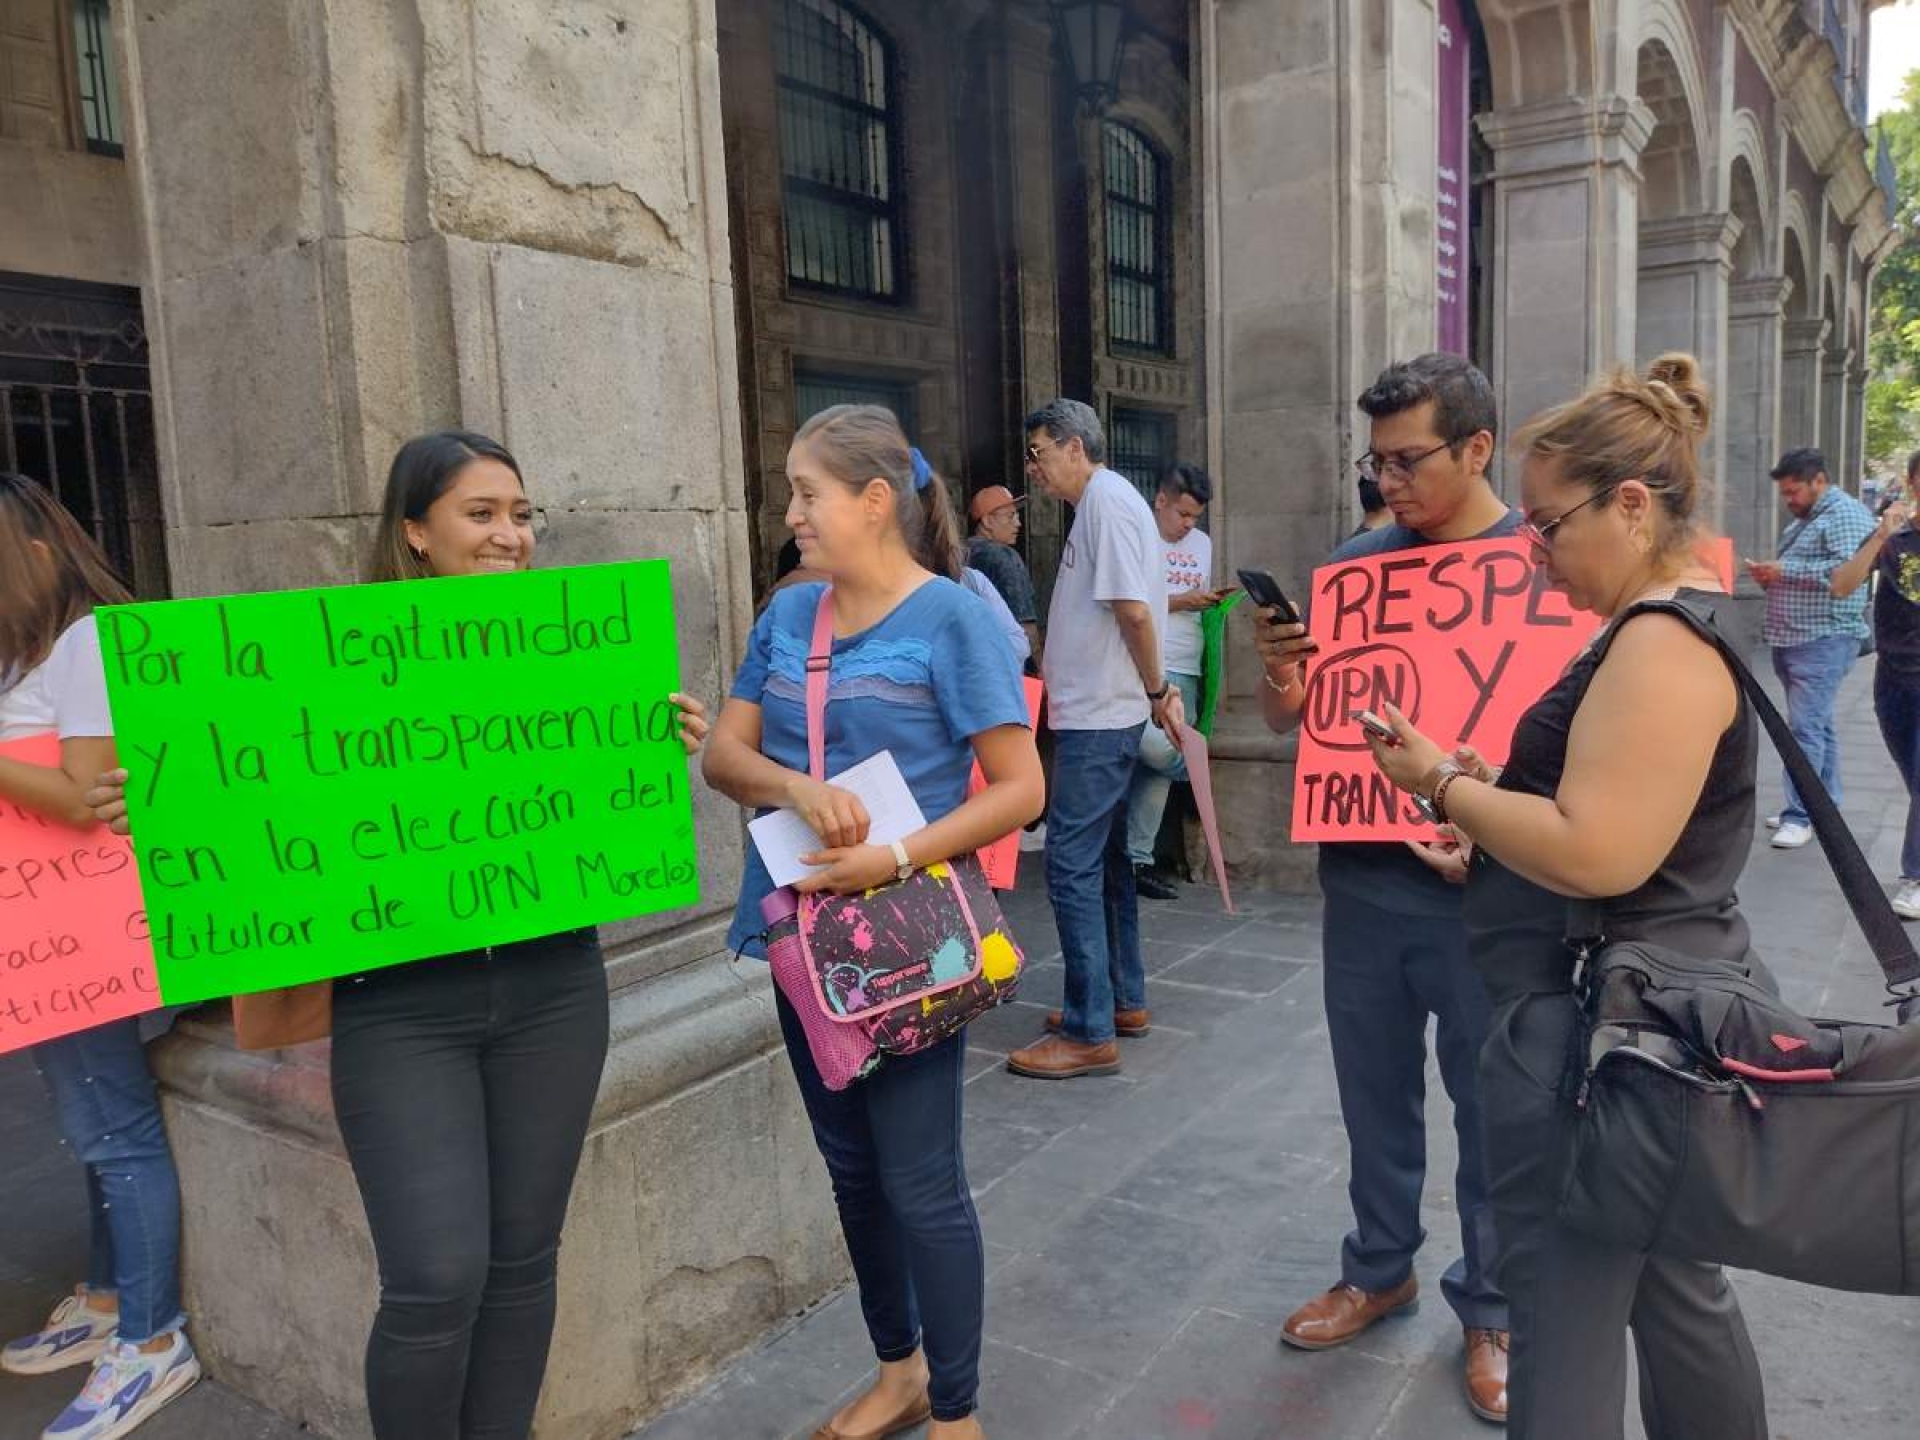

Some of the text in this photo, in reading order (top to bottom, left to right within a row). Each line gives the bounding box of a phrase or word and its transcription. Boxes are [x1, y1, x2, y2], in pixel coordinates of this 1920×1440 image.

[103, 578, 631, 686] Por la legitimidad
[208, 721, 269, 787] la
[291, 699, 683, 777] transparencia
[1314, 640, 1517, 743] UPN Y
[149, 768, 674, 888] en la elección del
[152, 850, 697, 960] titular de UPN Morelos
